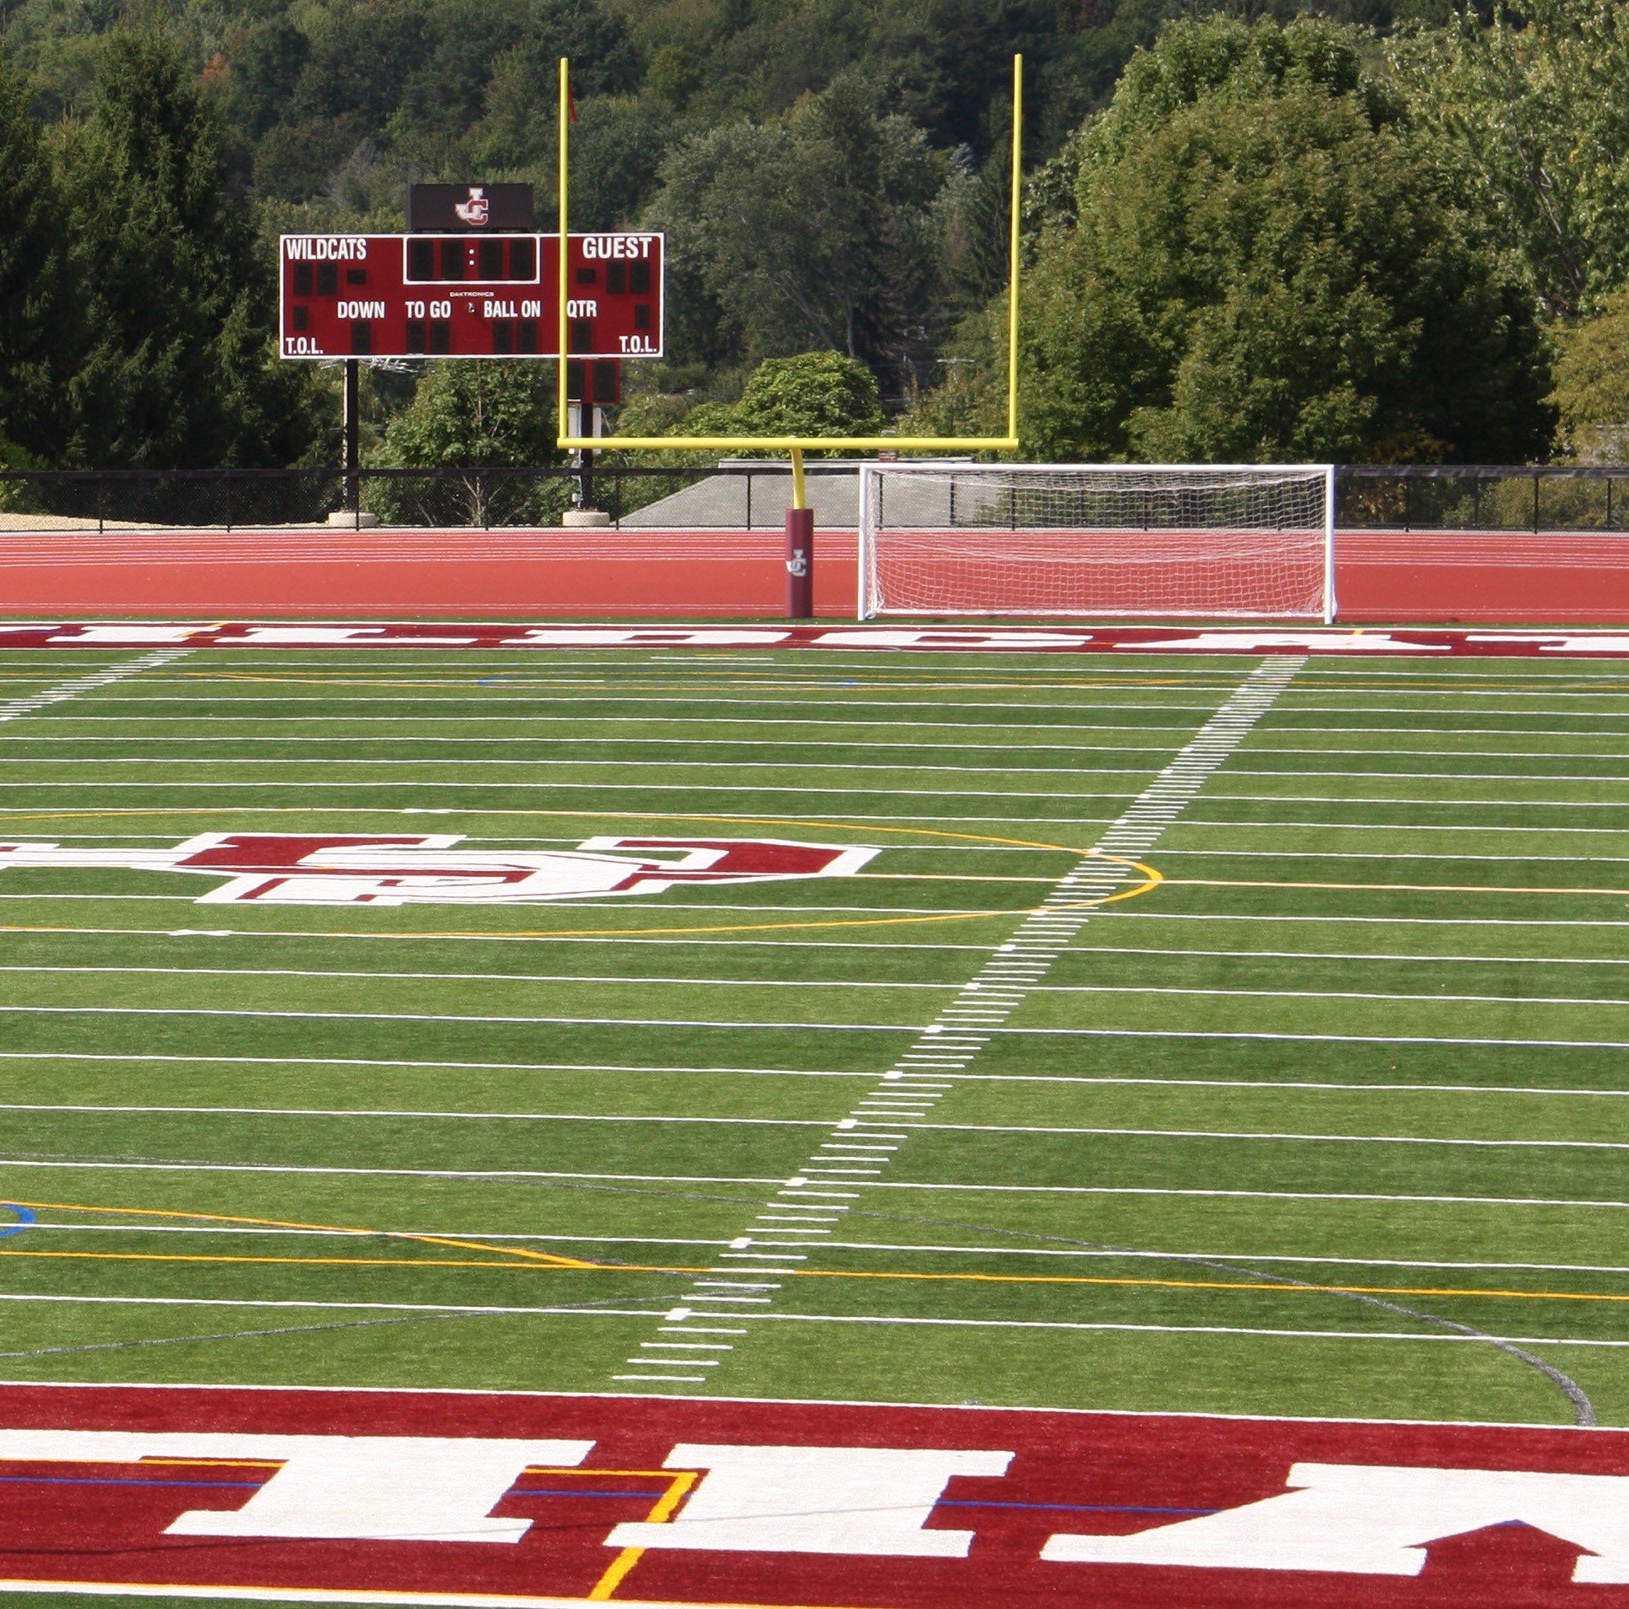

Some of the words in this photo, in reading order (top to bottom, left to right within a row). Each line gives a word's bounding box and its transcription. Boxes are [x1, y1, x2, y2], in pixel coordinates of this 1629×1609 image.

[286, 238, 366, 260] WILDCATS
[583, 237, 652, 259] GUEST
[337, 301, 385, 319] DOWN
[405, 301, 425, 318] TO
[430, 301, 452, 318] GO
[484, 301, 518, 318] BALL
[521, 300, 541, 318] ON
[567, 300, 597, 319] QTR
[286, 336, 324, 355] T.O.L.
[619, 335, 657, 353] T.O.L.
